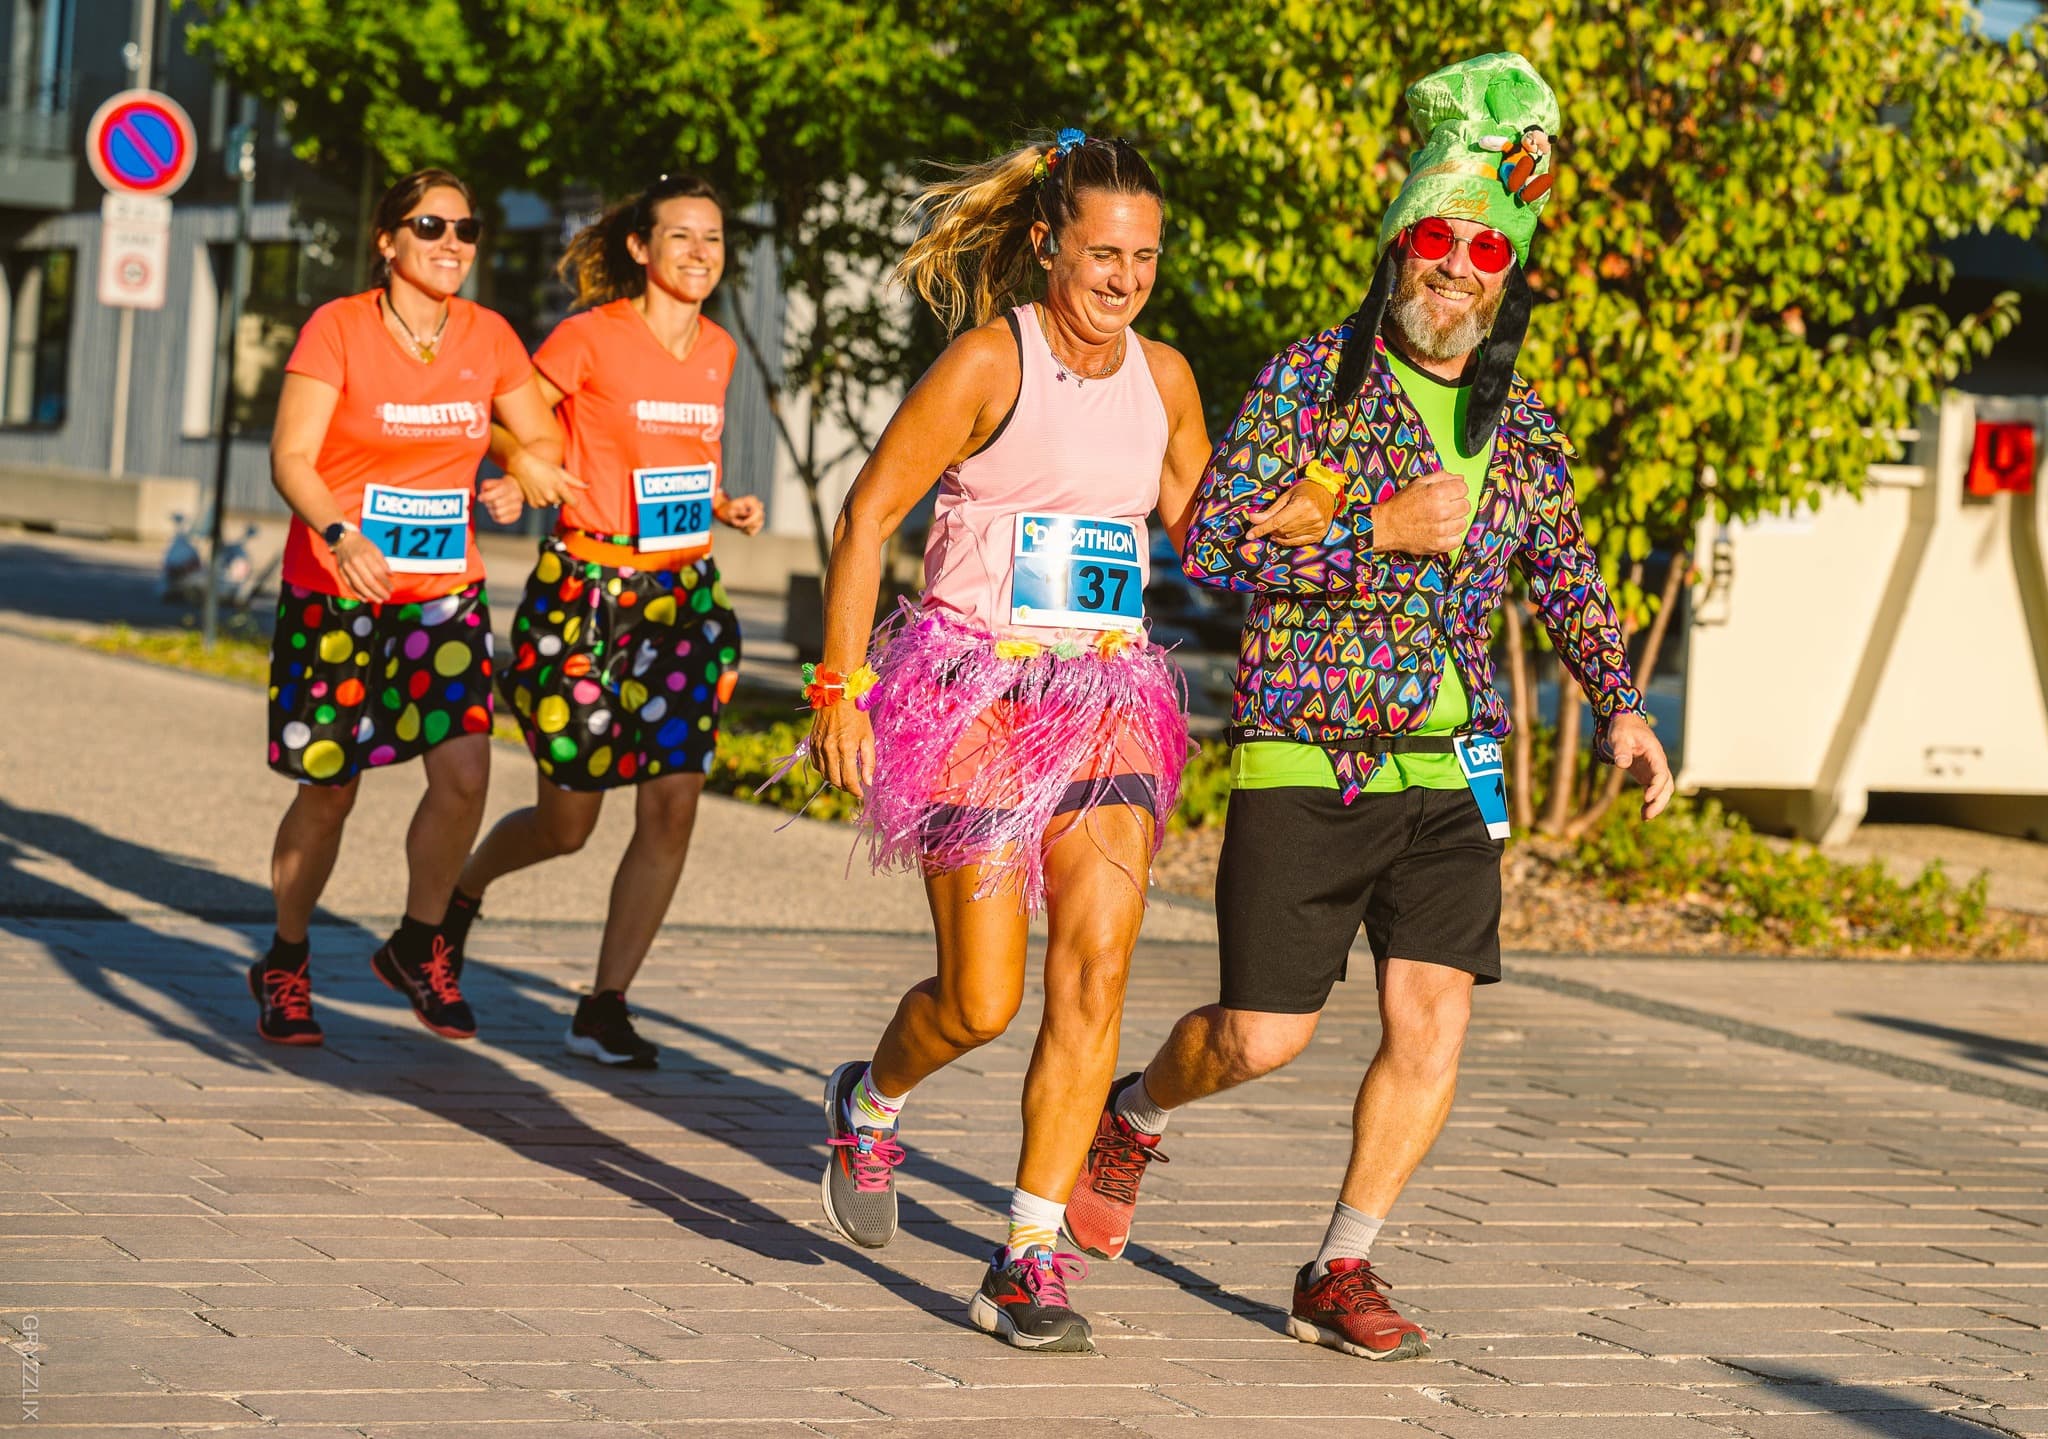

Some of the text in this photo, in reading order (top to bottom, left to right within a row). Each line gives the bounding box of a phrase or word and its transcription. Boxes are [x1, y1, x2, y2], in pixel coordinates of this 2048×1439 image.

[644, 474, 710, 495] DECATHLON
[376, 494, 460, 517] DECATHLON
[656, 502, 702, 535] 128
[384, 526, 453, 558] 127
[1032, 525, 1133, 554] DATHLON
[1077, 566, 1129, 612] 37
[1467, 742, 1502, 766] DEC
